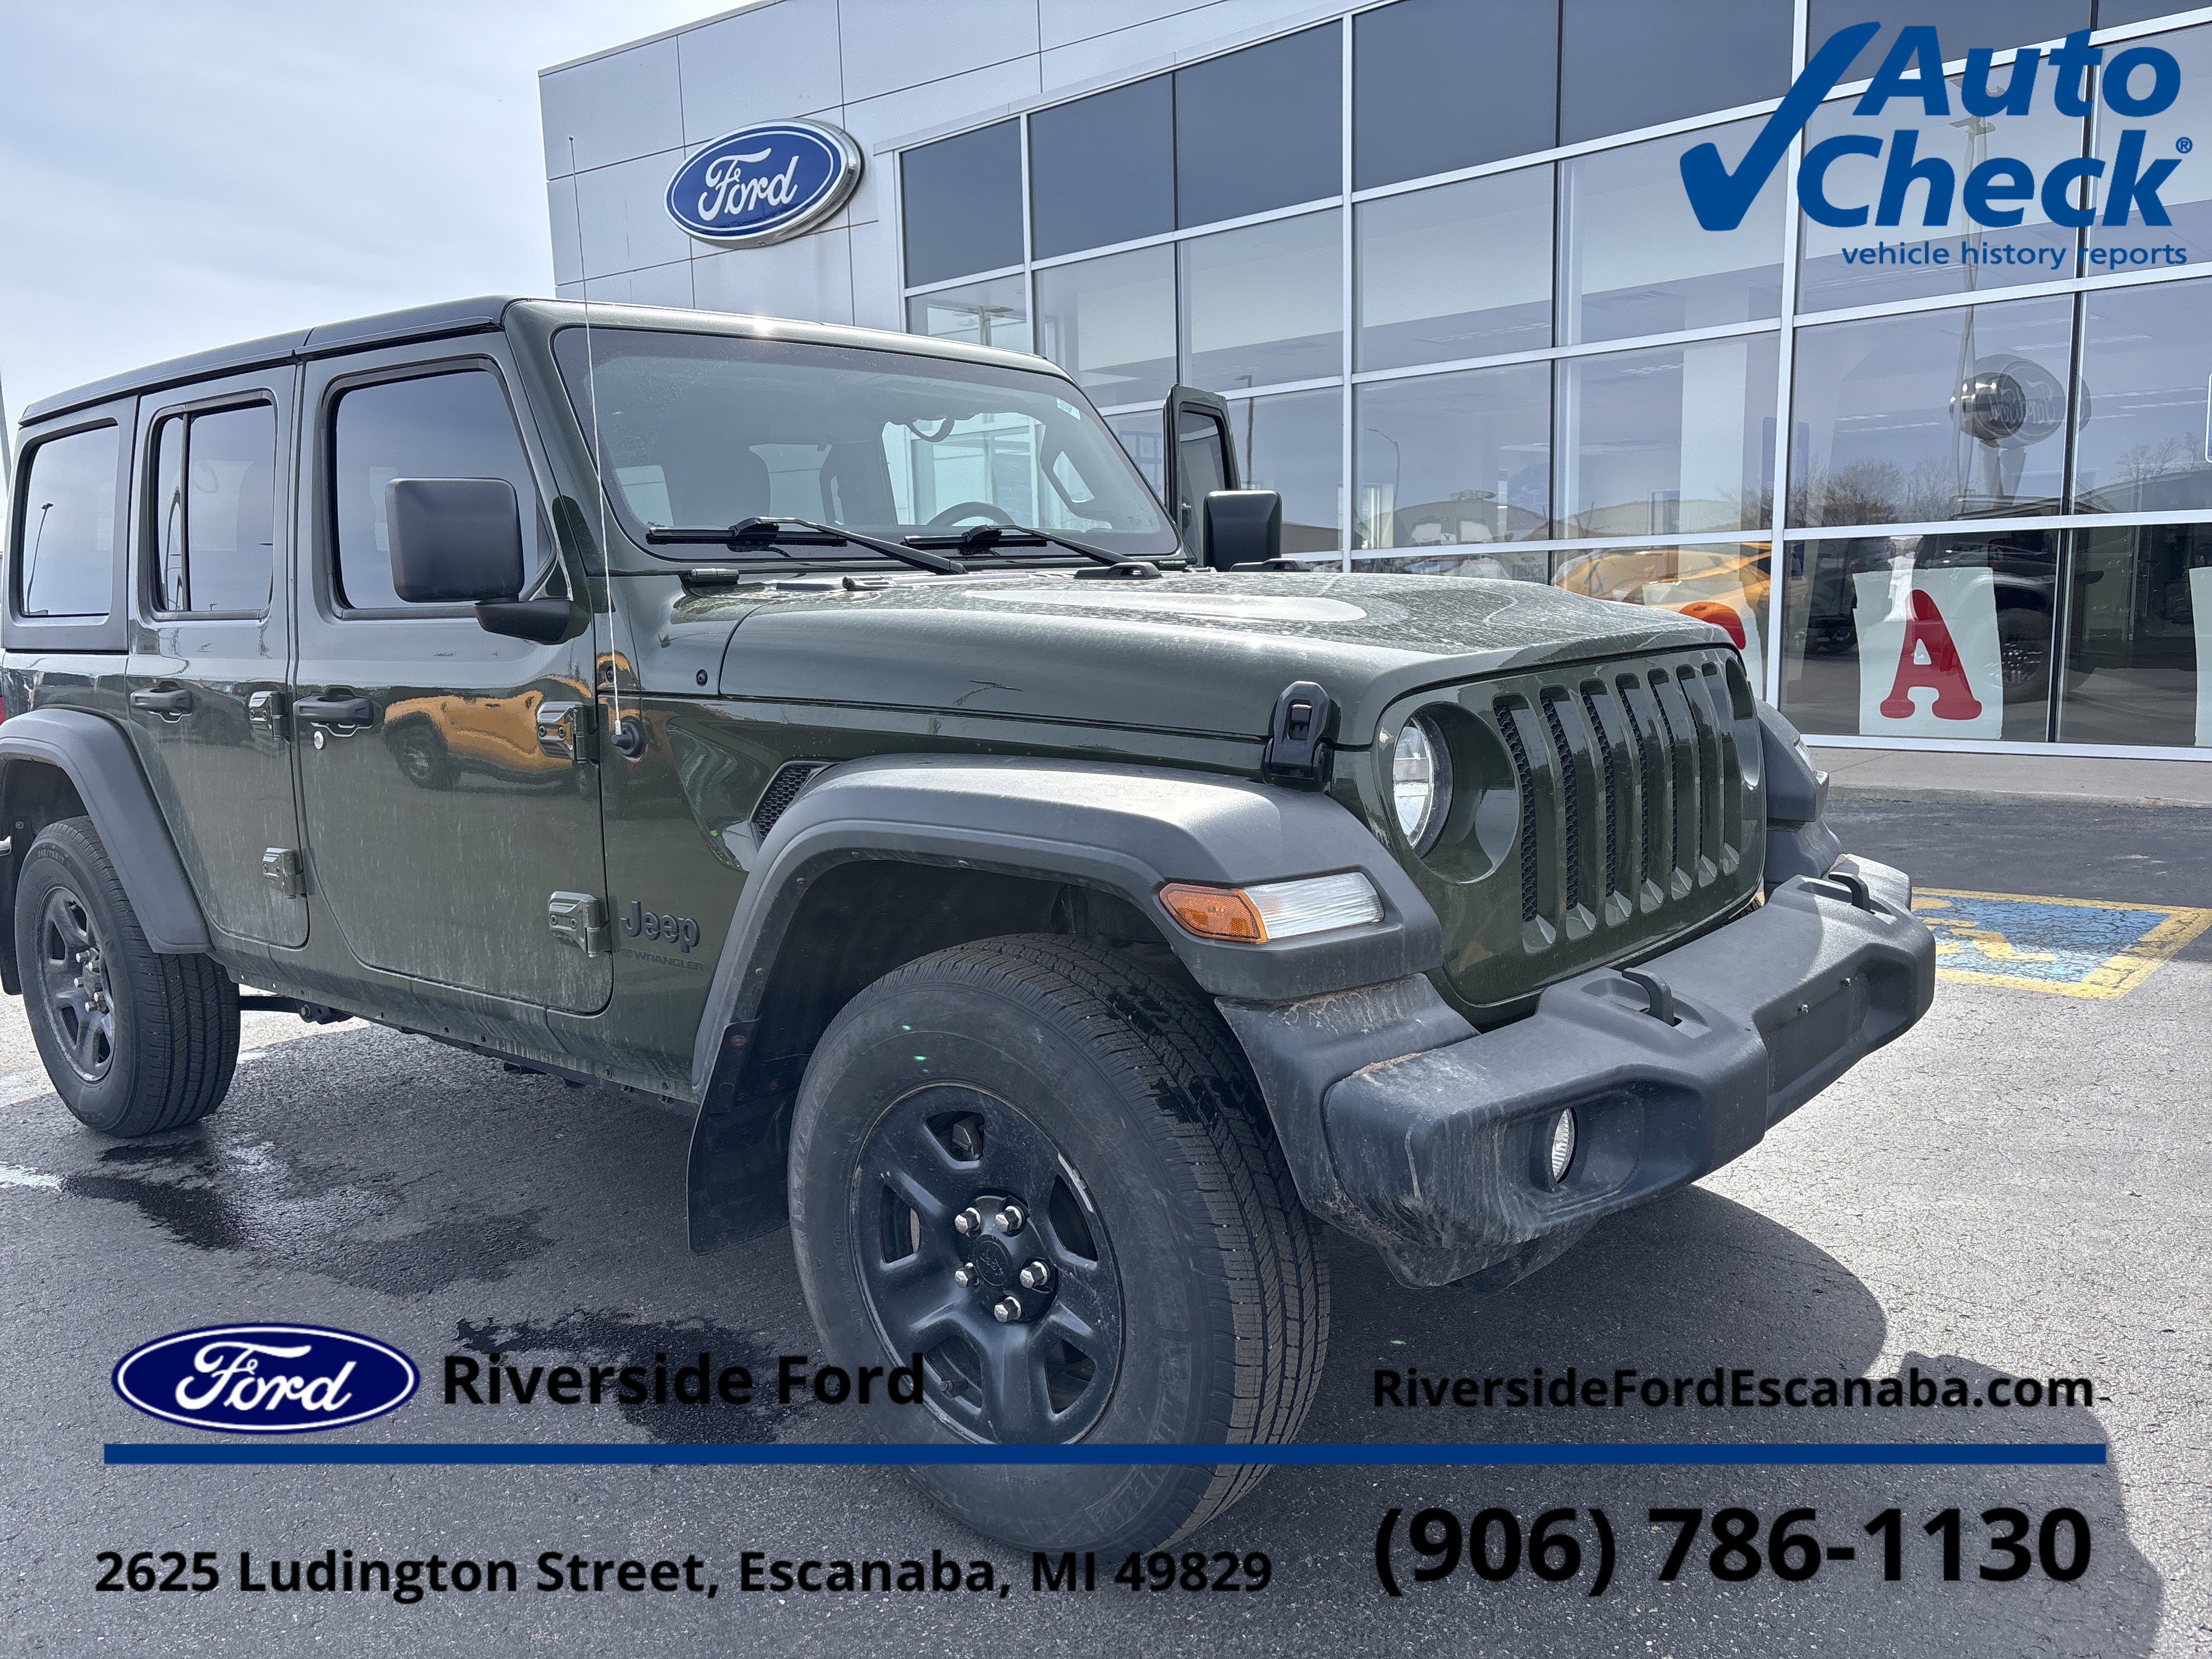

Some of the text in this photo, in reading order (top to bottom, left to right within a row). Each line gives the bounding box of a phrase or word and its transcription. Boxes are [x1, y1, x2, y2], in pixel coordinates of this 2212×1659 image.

[698, 147, 799, 221] Ford
[1880, 589, 1983, 720] A
[620, 900, 700, 953] Jeep
[635, 951, 705, 972] WRANGLER
